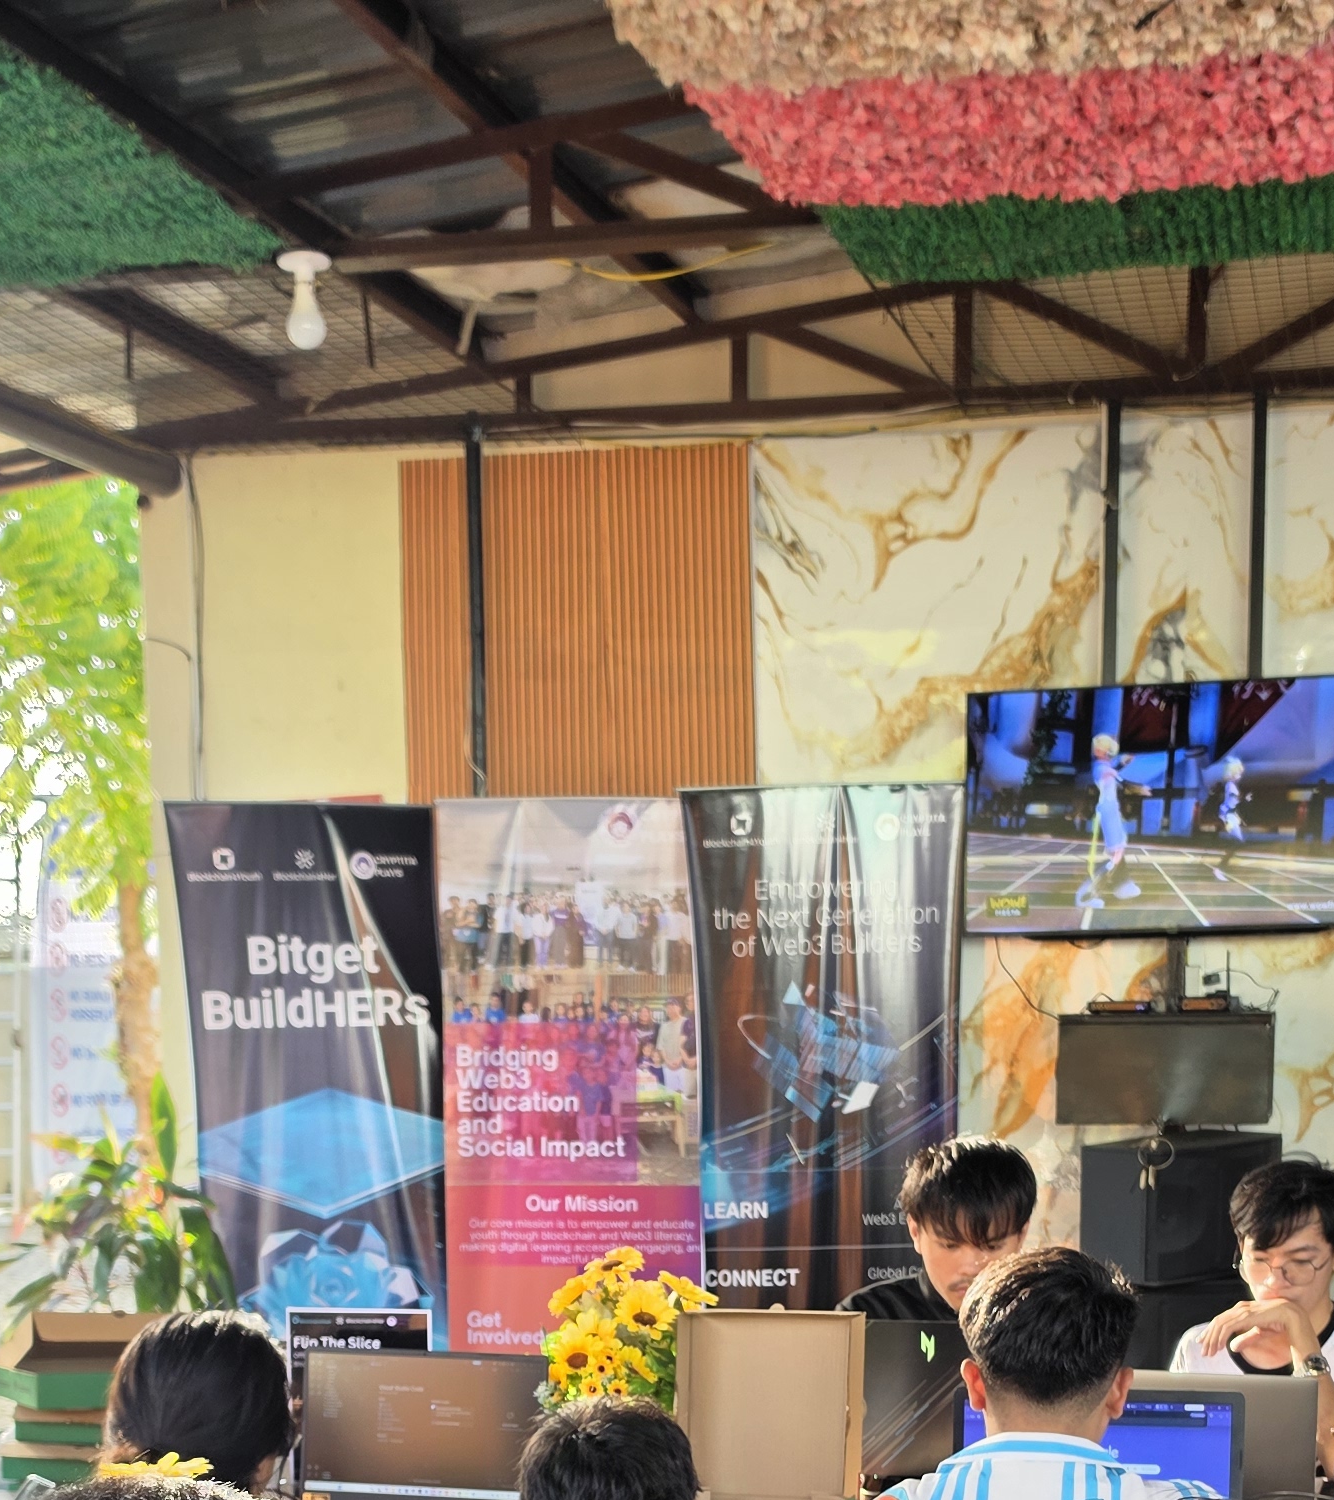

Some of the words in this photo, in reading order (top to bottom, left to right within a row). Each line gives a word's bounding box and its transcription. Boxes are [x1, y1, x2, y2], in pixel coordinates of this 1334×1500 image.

[754, 879, 897, 902] Empowering
[713, 907, 751, 930] the
[756, 906, 811, 929] Next
[816, 904, 941, 927] Generation
[731, 935, 758, 958] of
[761, 933, 824, 957] Web3
[831, 931, 923, 955] Builders
[246, 933, 380, 984] Bitget
[455, 1043, 559, 1072] Bridging
[455, 1068, 532, 1090] Web3
[456, 1091, 579, 1113] Education
[456, 1114, 503, 1135] and
[457, 1135, 534, 1158] Social
[540, 1136, 626, 1162] Impact
[525, 1194, 560, 1212] Our
[564, 1194, 639, 1212] Mission
[703, 1201, 769, 1219] LEARN
[469, 1218, 488, 1229] Our
[489, 1219, 513, 1229] core
[515, 1218, 554, 1229] mission
[556, 1218, 565, 1229] is
[567, 1218, 578, 1229] to
[580, 1219, 630, 1231] empower
[631, 1218, 651, 1229] and
[652, 1218, 696, 1229] educate
[861, 1212, 897, 1226] Web3
[469, 1231, 498, 1242] youth
[500, 1231, 539, 1242] through
[541, 1231, 597, 1241] blockchain
[598, 1231, 617, 1241] and
[620, 1231, 652, 1241] Web3
[459, 1243, 496, 1254] making
[498, 1242, 529, 1254] digital
[530, 1242, 571, 1254] learning
[705, 1267, 800, 1287] CONNECT
[867, 1265, 906, 1281] Global
[467, 1310, 503, 1328] Get
[320, 1335, 346, 1349] The
[347, 1335, 382, 1350] Slice
[467, 1328, 545, 1345] Involved
